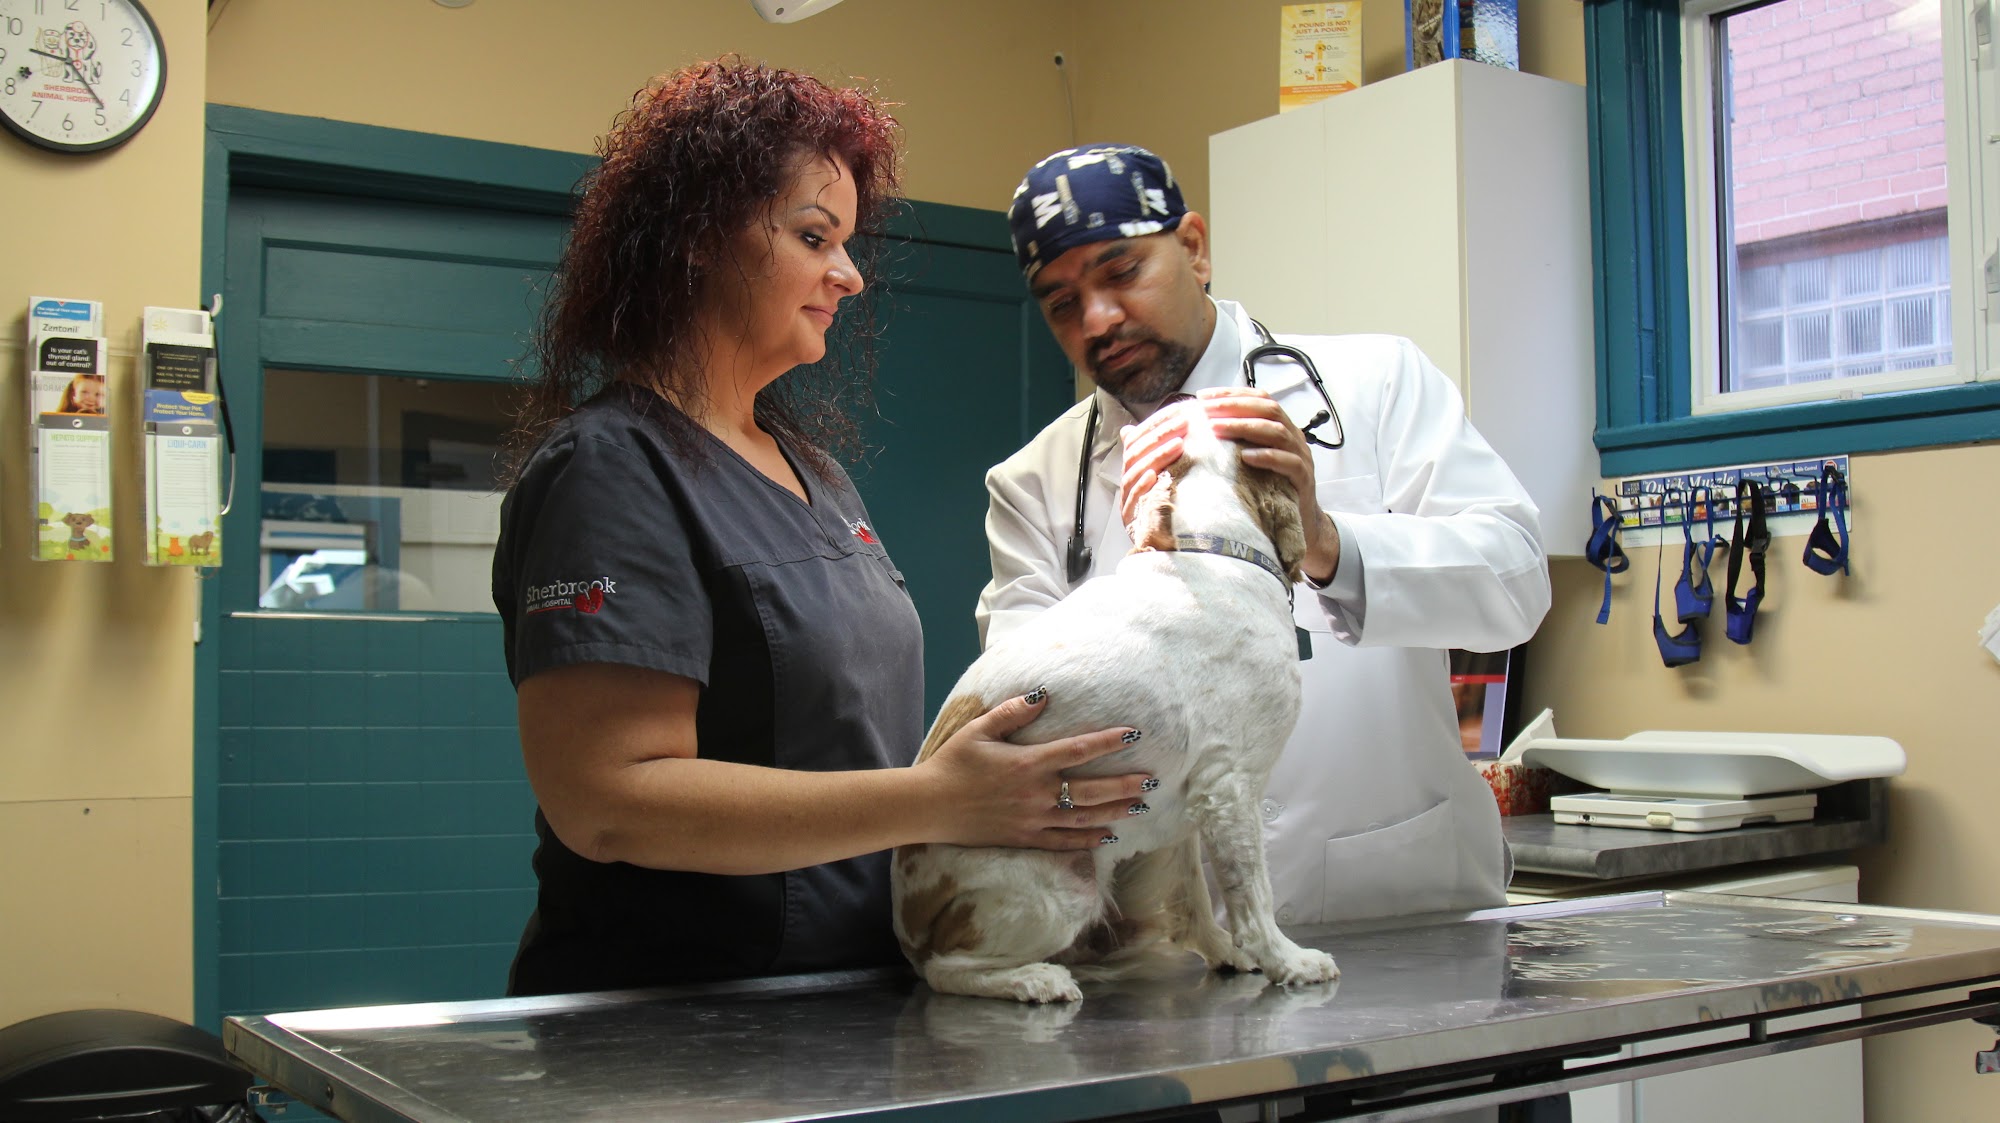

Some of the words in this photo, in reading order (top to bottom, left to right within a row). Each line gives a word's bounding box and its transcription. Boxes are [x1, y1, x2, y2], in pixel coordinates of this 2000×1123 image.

[6, 16, 23, 36] 10
[1298, 21, 1326, 29] POUND
[120, 27, 134, 47] 2
[130, 59, 142, 78] 3
[5, 77, 16, 96] 8
[43, 84, 93, 94] SHERBROO
[32, 91, 64, 101] ANIMAL
[119, 88, 130, 107] 4
[31, 100, 43, 118] 7
[94, 107, 106, 126] 5
[62, 113, 74, 131] 6
[42, 323, 79, 334] Zentonil
[167, 439, 208, 449] LIQUI-CARN
[1804, 464, 1818, 472] Control
[1645, 477, 1685, 494] Quik
[1229, 540, 1249, 559] W
[526, 576, 616, 604] Sherbrook
[541, 598, 572, 608] HOSPITAL
